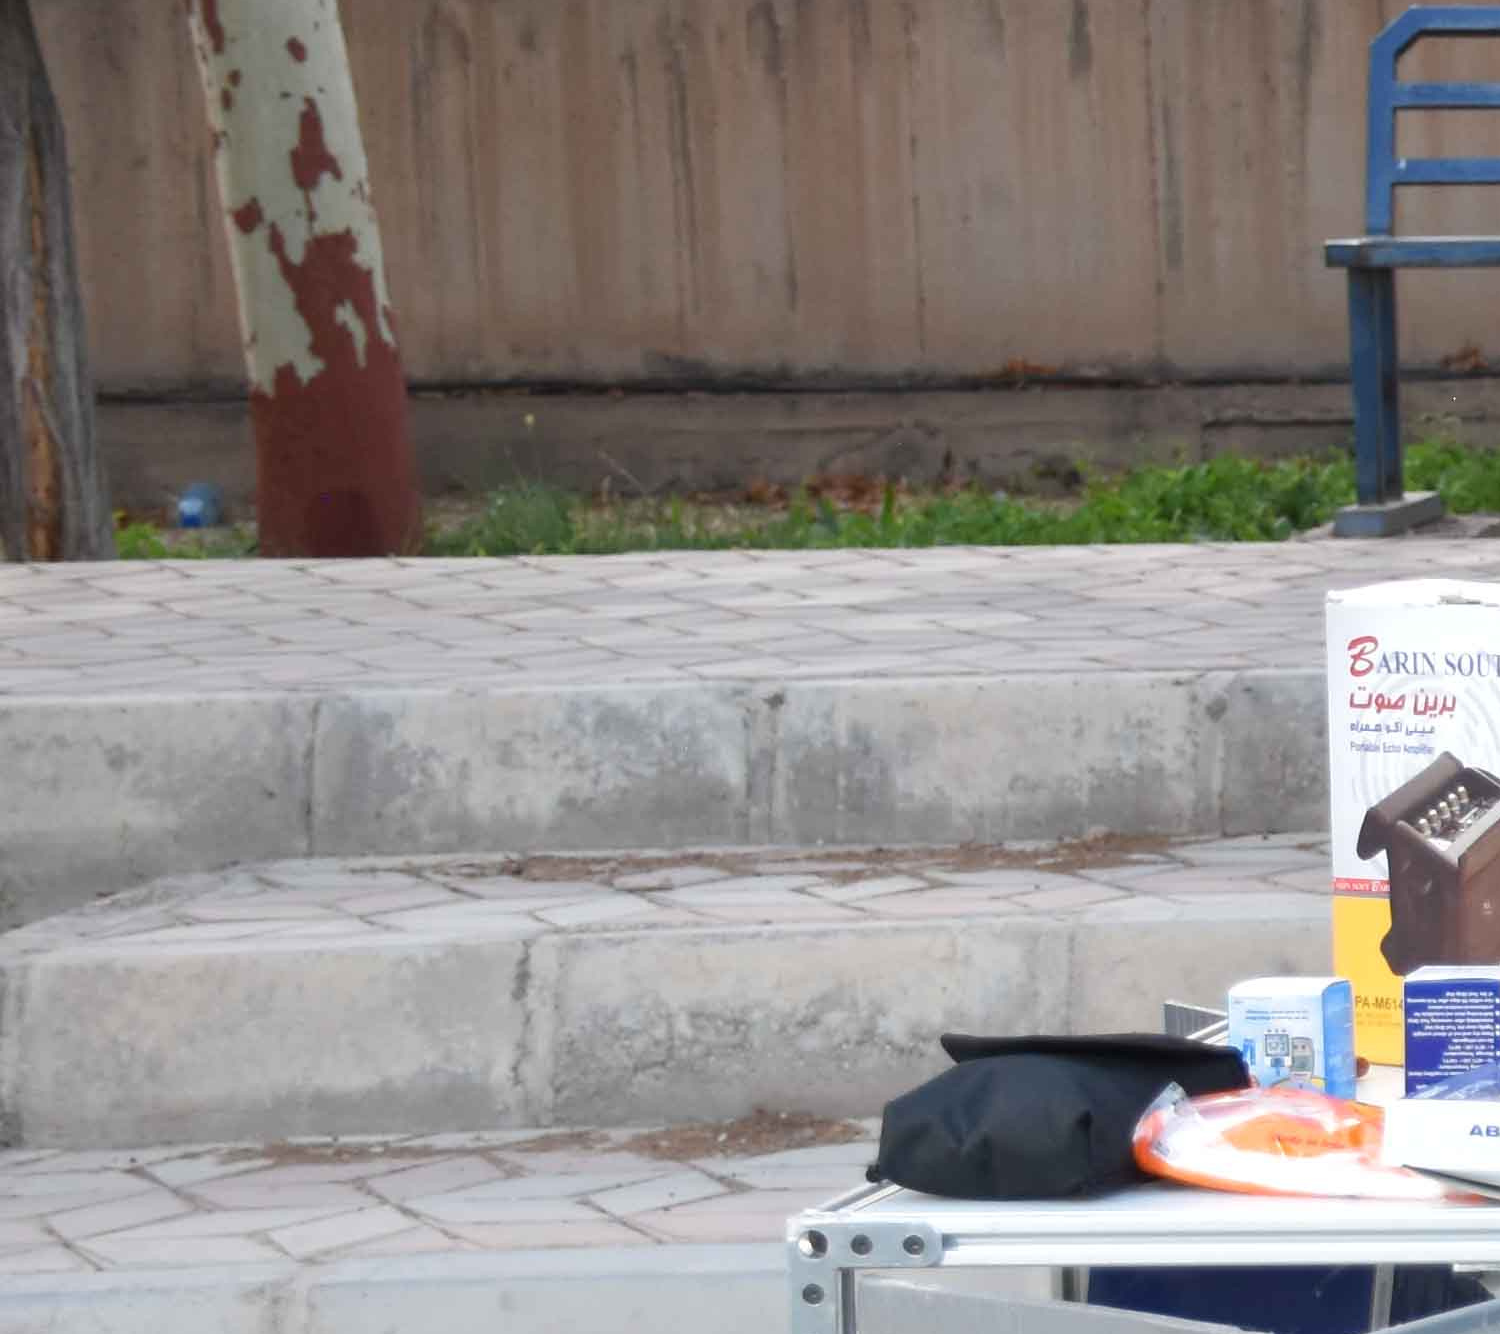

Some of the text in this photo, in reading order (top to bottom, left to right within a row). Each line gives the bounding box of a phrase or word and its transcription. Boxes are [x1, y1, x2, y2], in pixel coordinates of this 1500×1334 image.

[1347, 635, 1437, 678] BARIN
[1349, 686, 1457, 718] برین صوت
[1350, 720, 1435, 736] مینی اکو همراه
